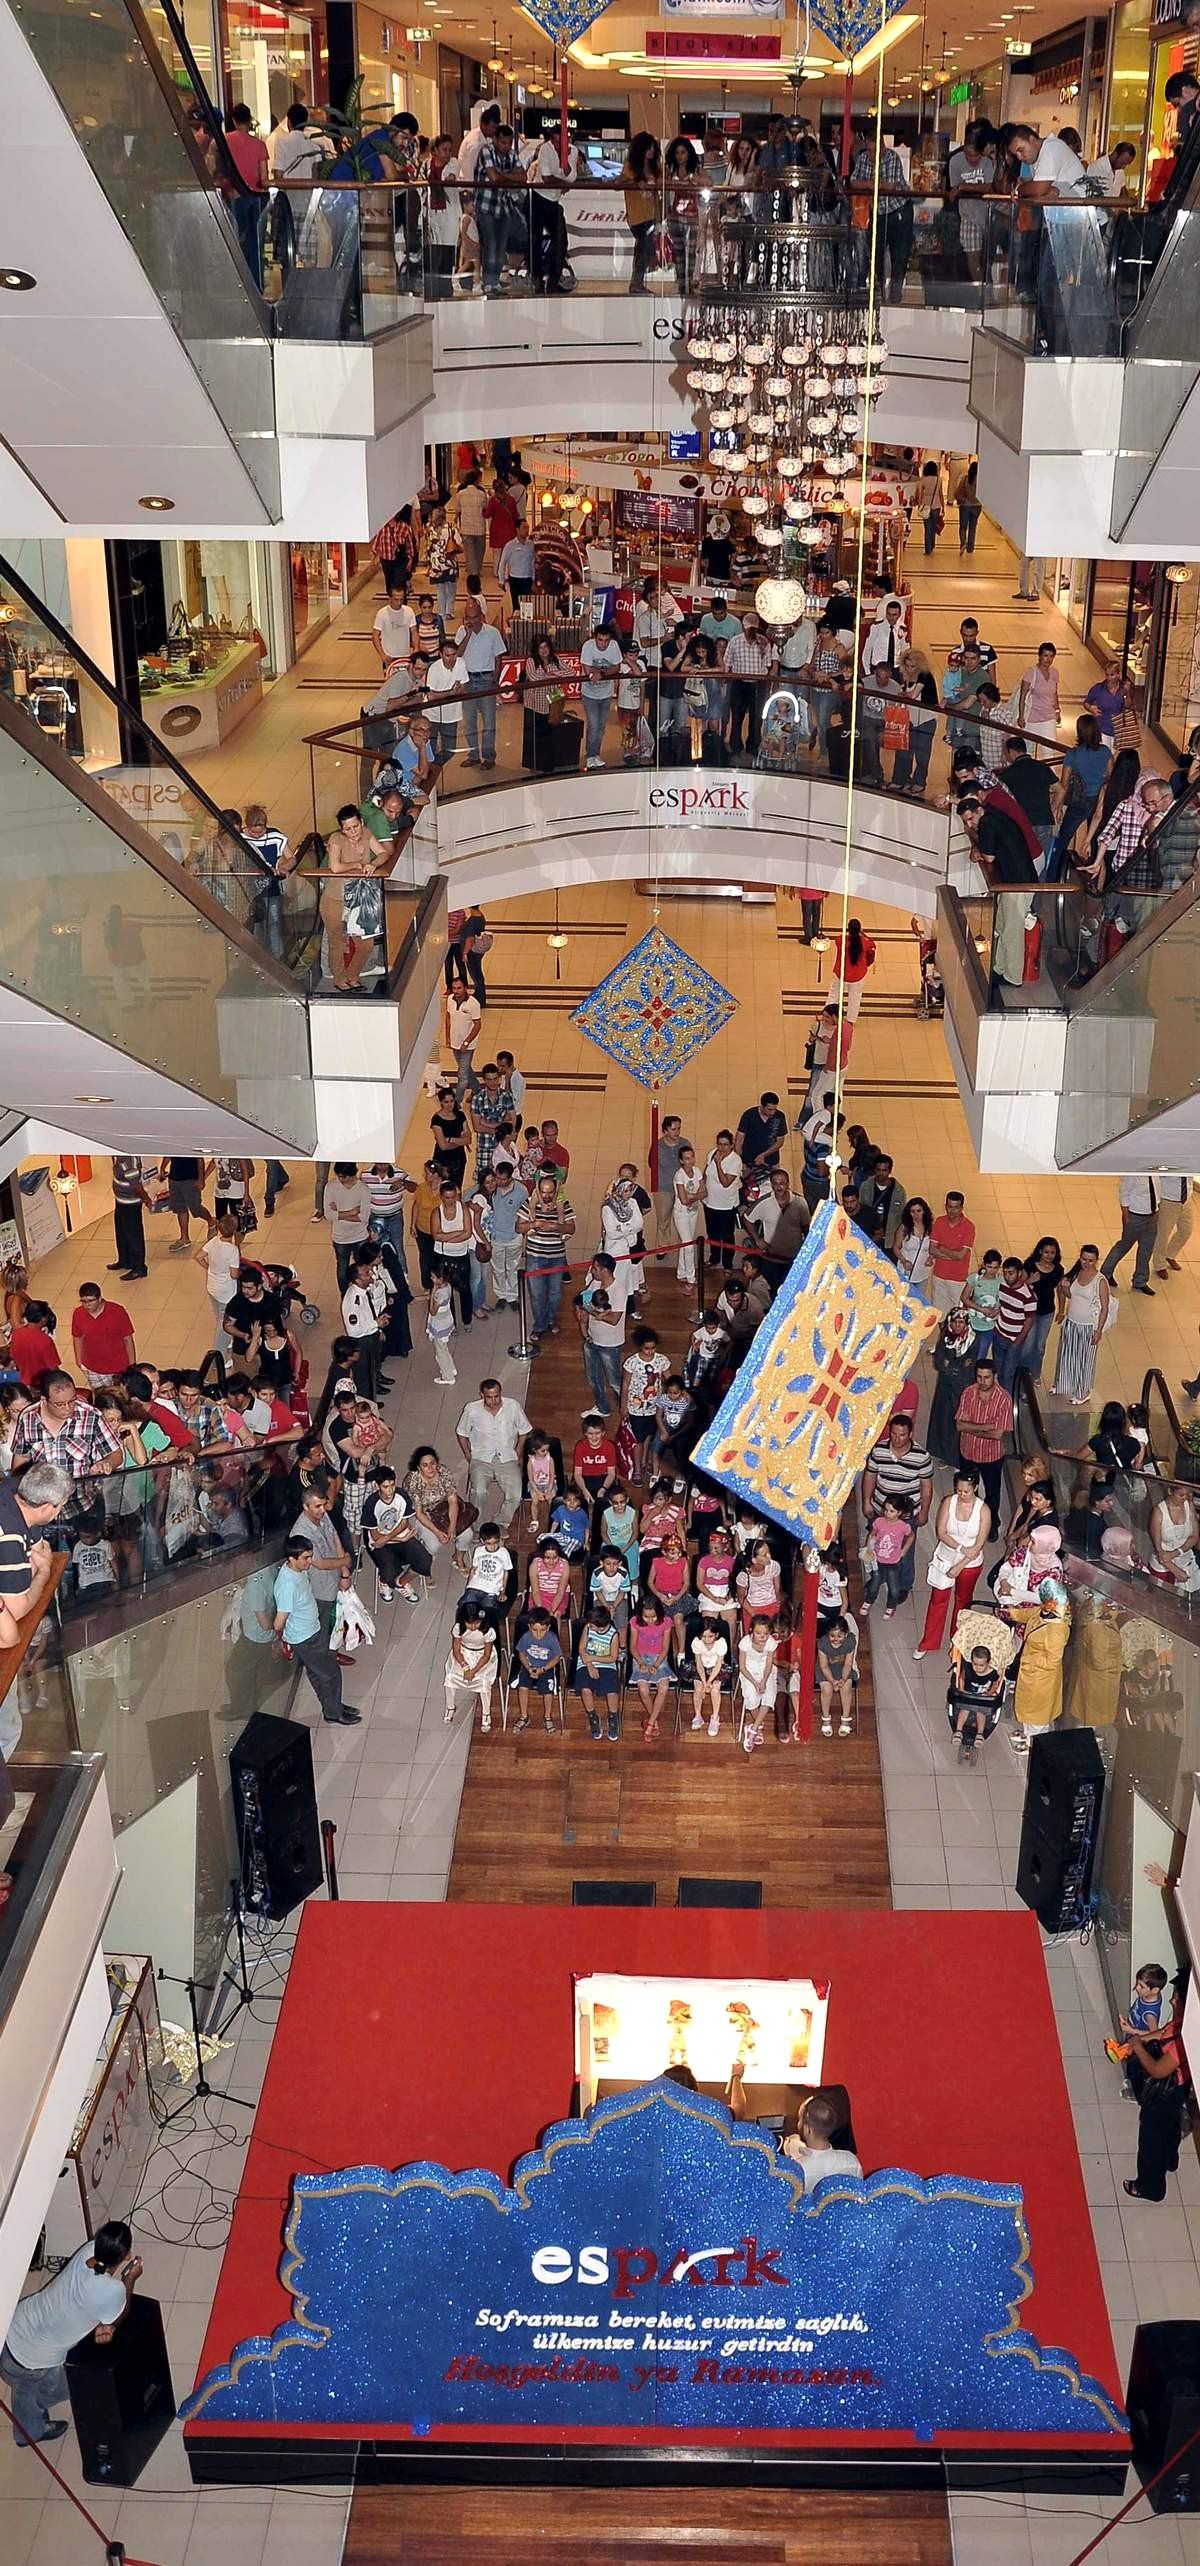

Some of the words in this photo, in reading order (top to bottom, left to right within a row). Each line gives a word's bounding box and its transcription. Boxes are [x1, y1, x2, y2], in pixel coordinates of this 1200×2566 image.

[541, 116, 578, 128] Berska
[649, 782, 749, 815] espark
[531, 2234, 791, 2299] espark
[701, 2313, 787, 2330] evimize
[533, 2332, 635, 2351] ülkemize
[642, 2333, 712, 2351] huzur
[720, 2335, 815, 2357] getirdin
[629, 2365, 679, 2392] ya
